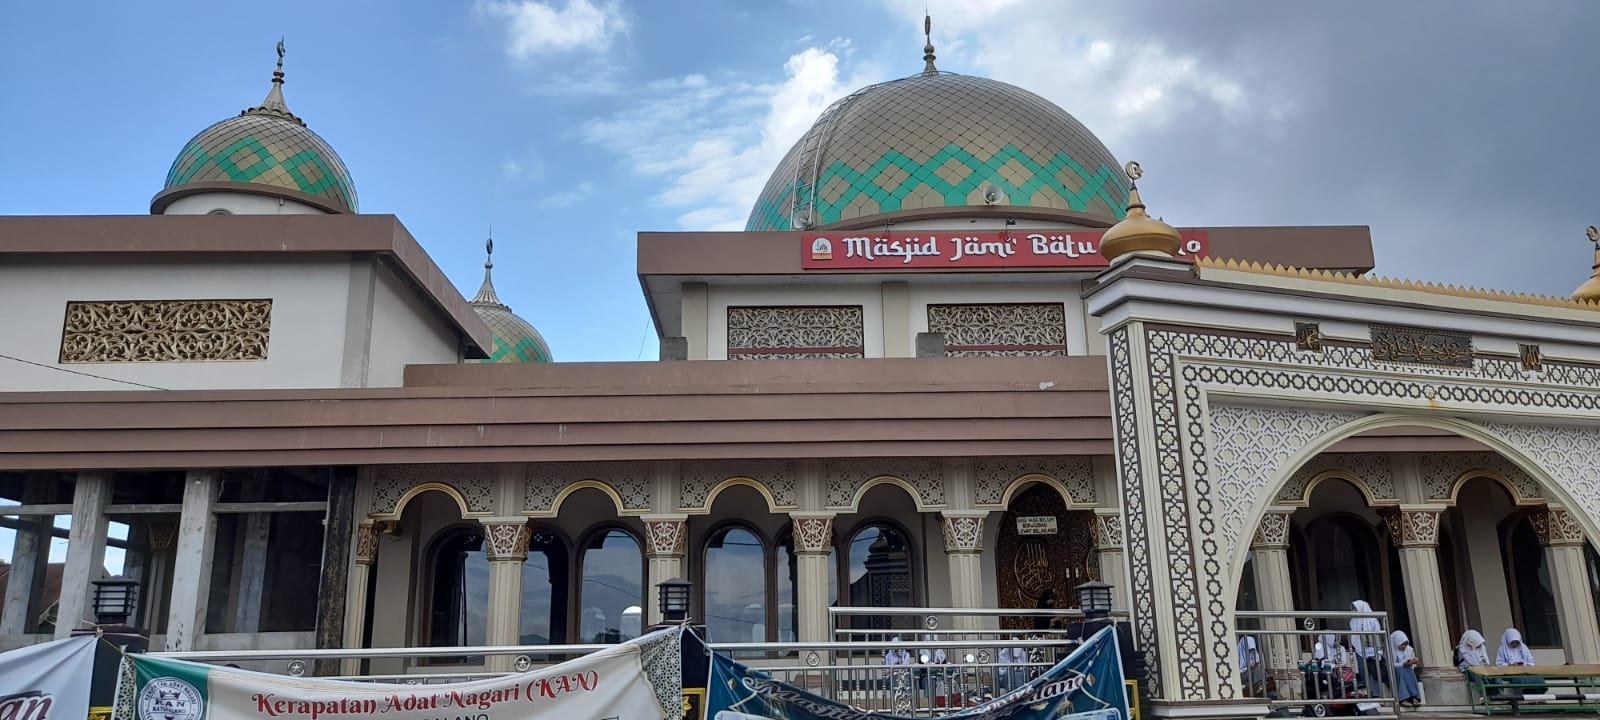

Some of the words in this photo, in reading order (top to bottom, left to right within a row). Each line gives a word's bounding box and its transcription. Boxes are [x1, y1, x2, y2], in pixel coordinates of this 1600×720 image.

[251, 693, 377, 720] Kerapatan
[380, 694, 440, 714] Adat
[443, 684, 520, 710] Nagari
[526, 670, 599, 702] (KAN)
